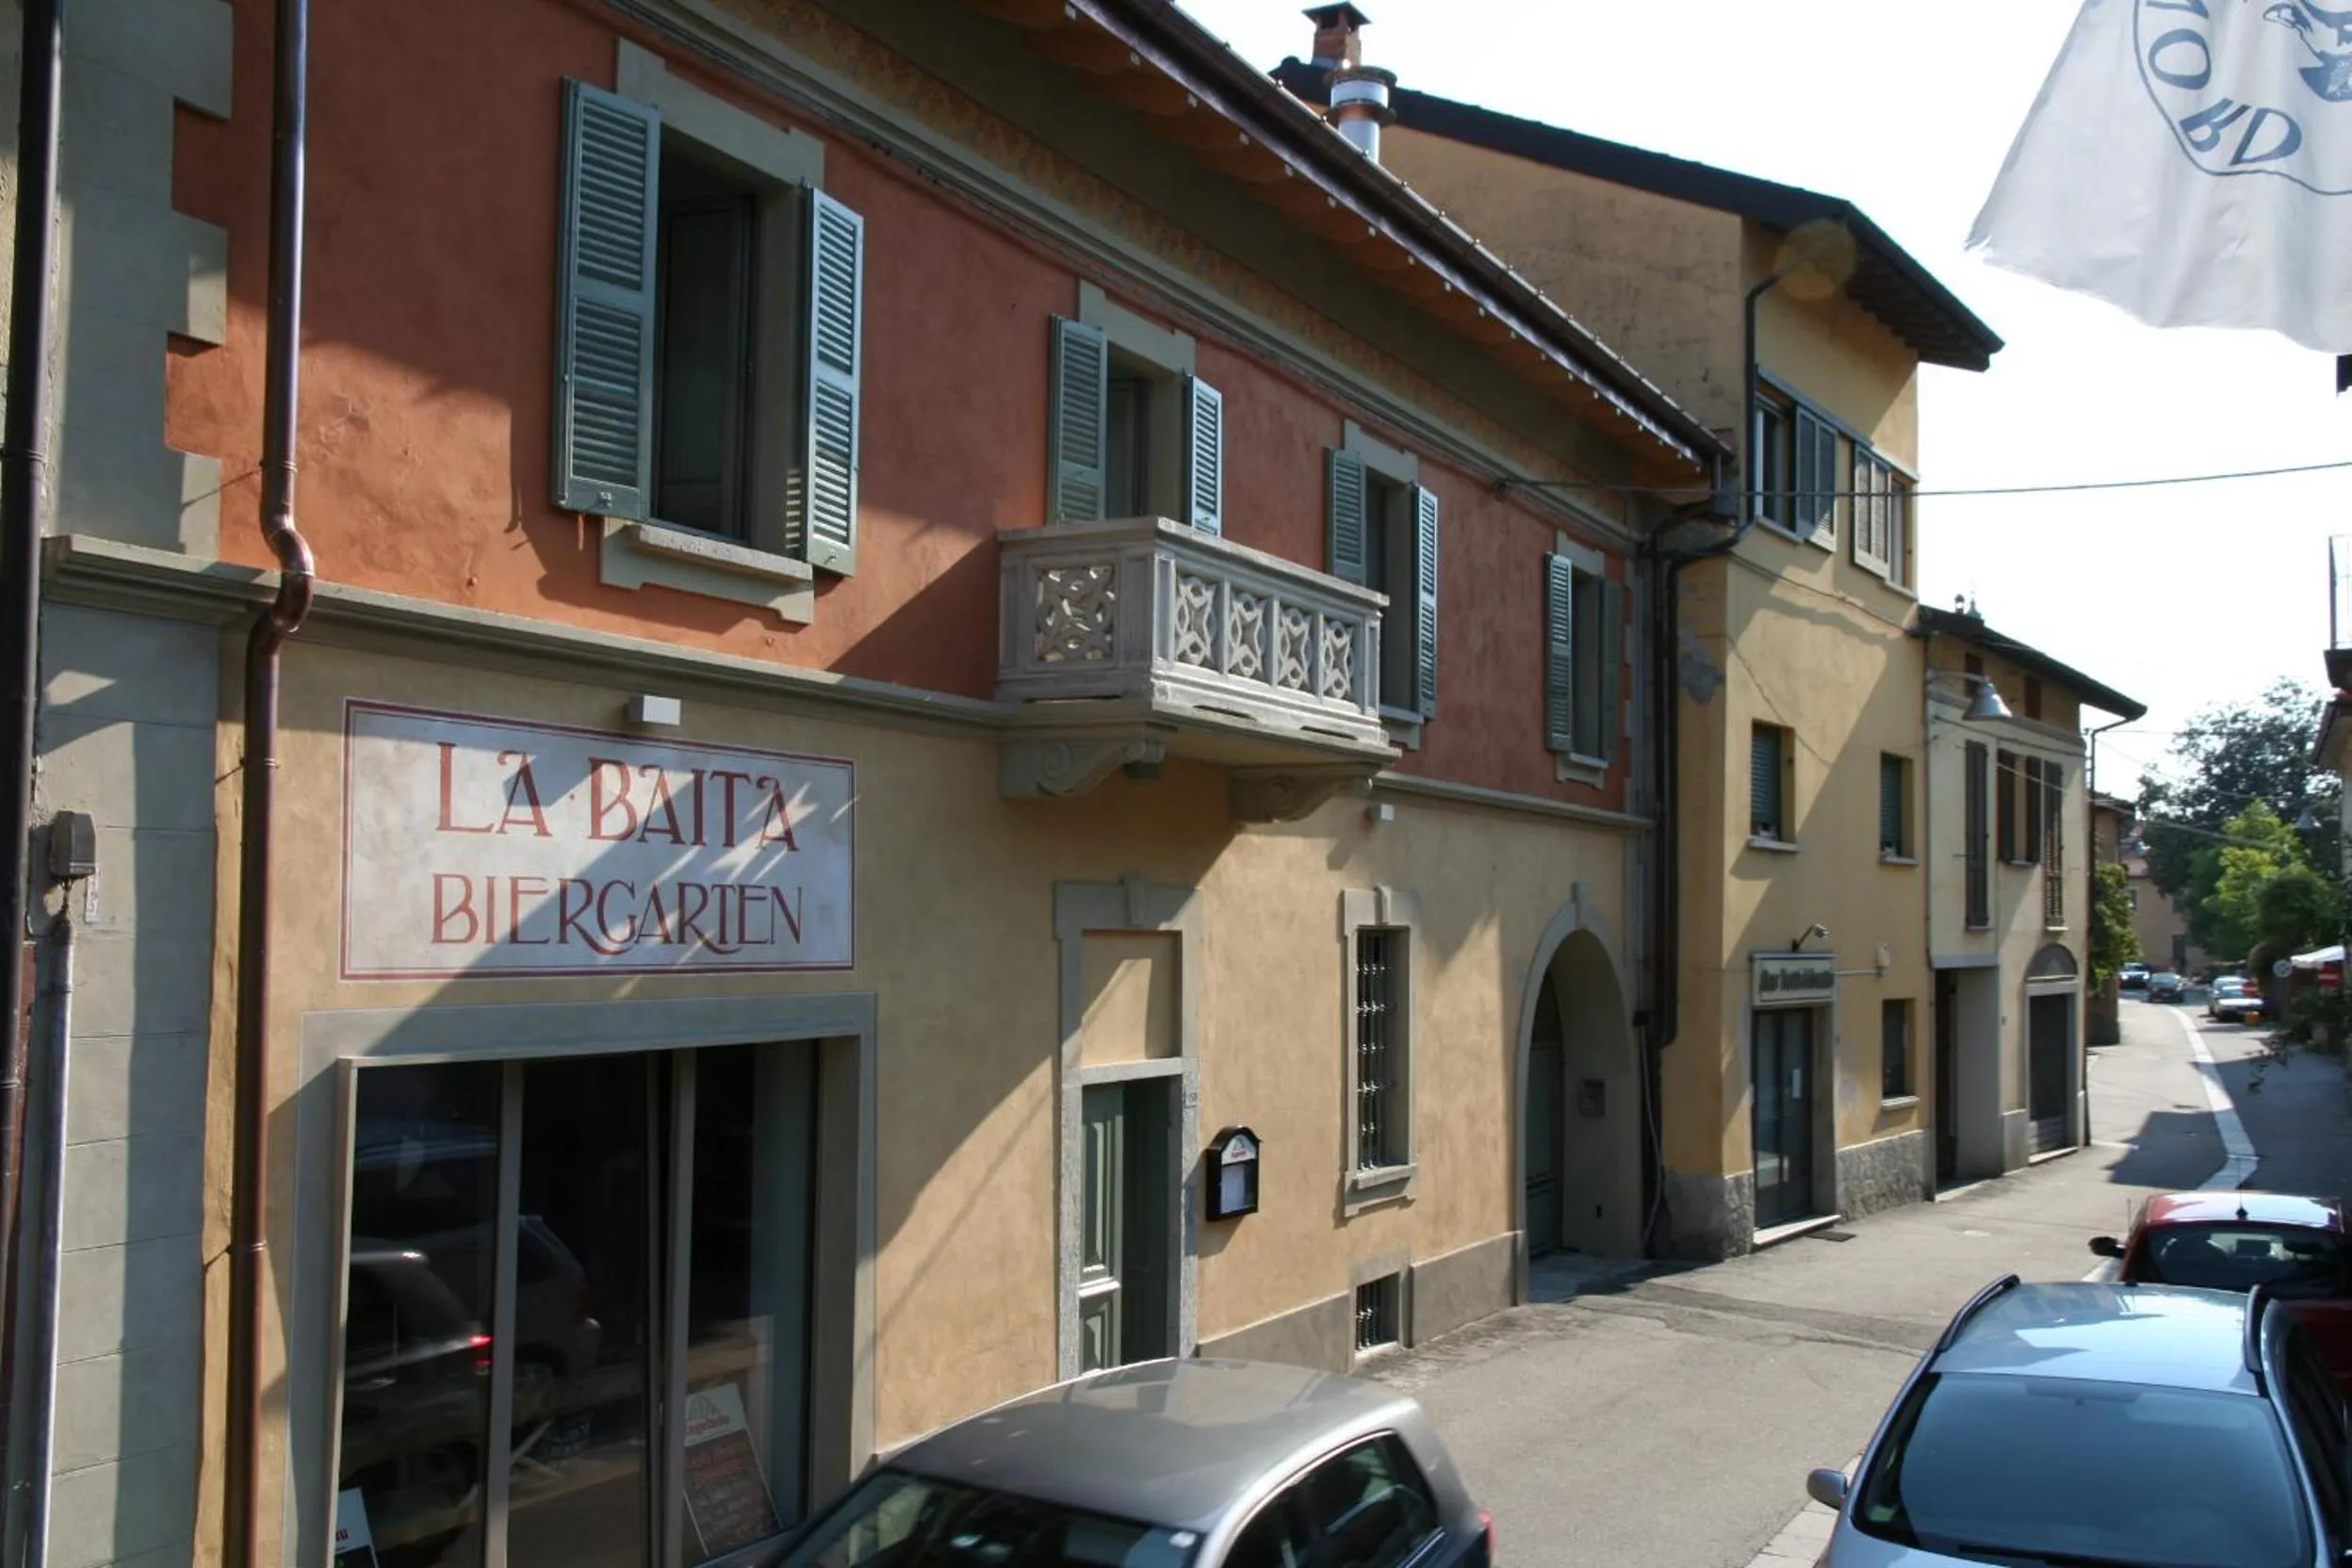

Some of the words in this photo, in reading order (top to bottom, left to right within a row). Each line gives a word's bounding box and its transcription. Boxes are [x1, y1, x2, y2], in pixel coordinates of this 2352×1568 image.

[436, 742, 552, 837] LA
[587, 756, 800, 851] BAITA
[431, 873, 804, 955] BIERGARTEN
